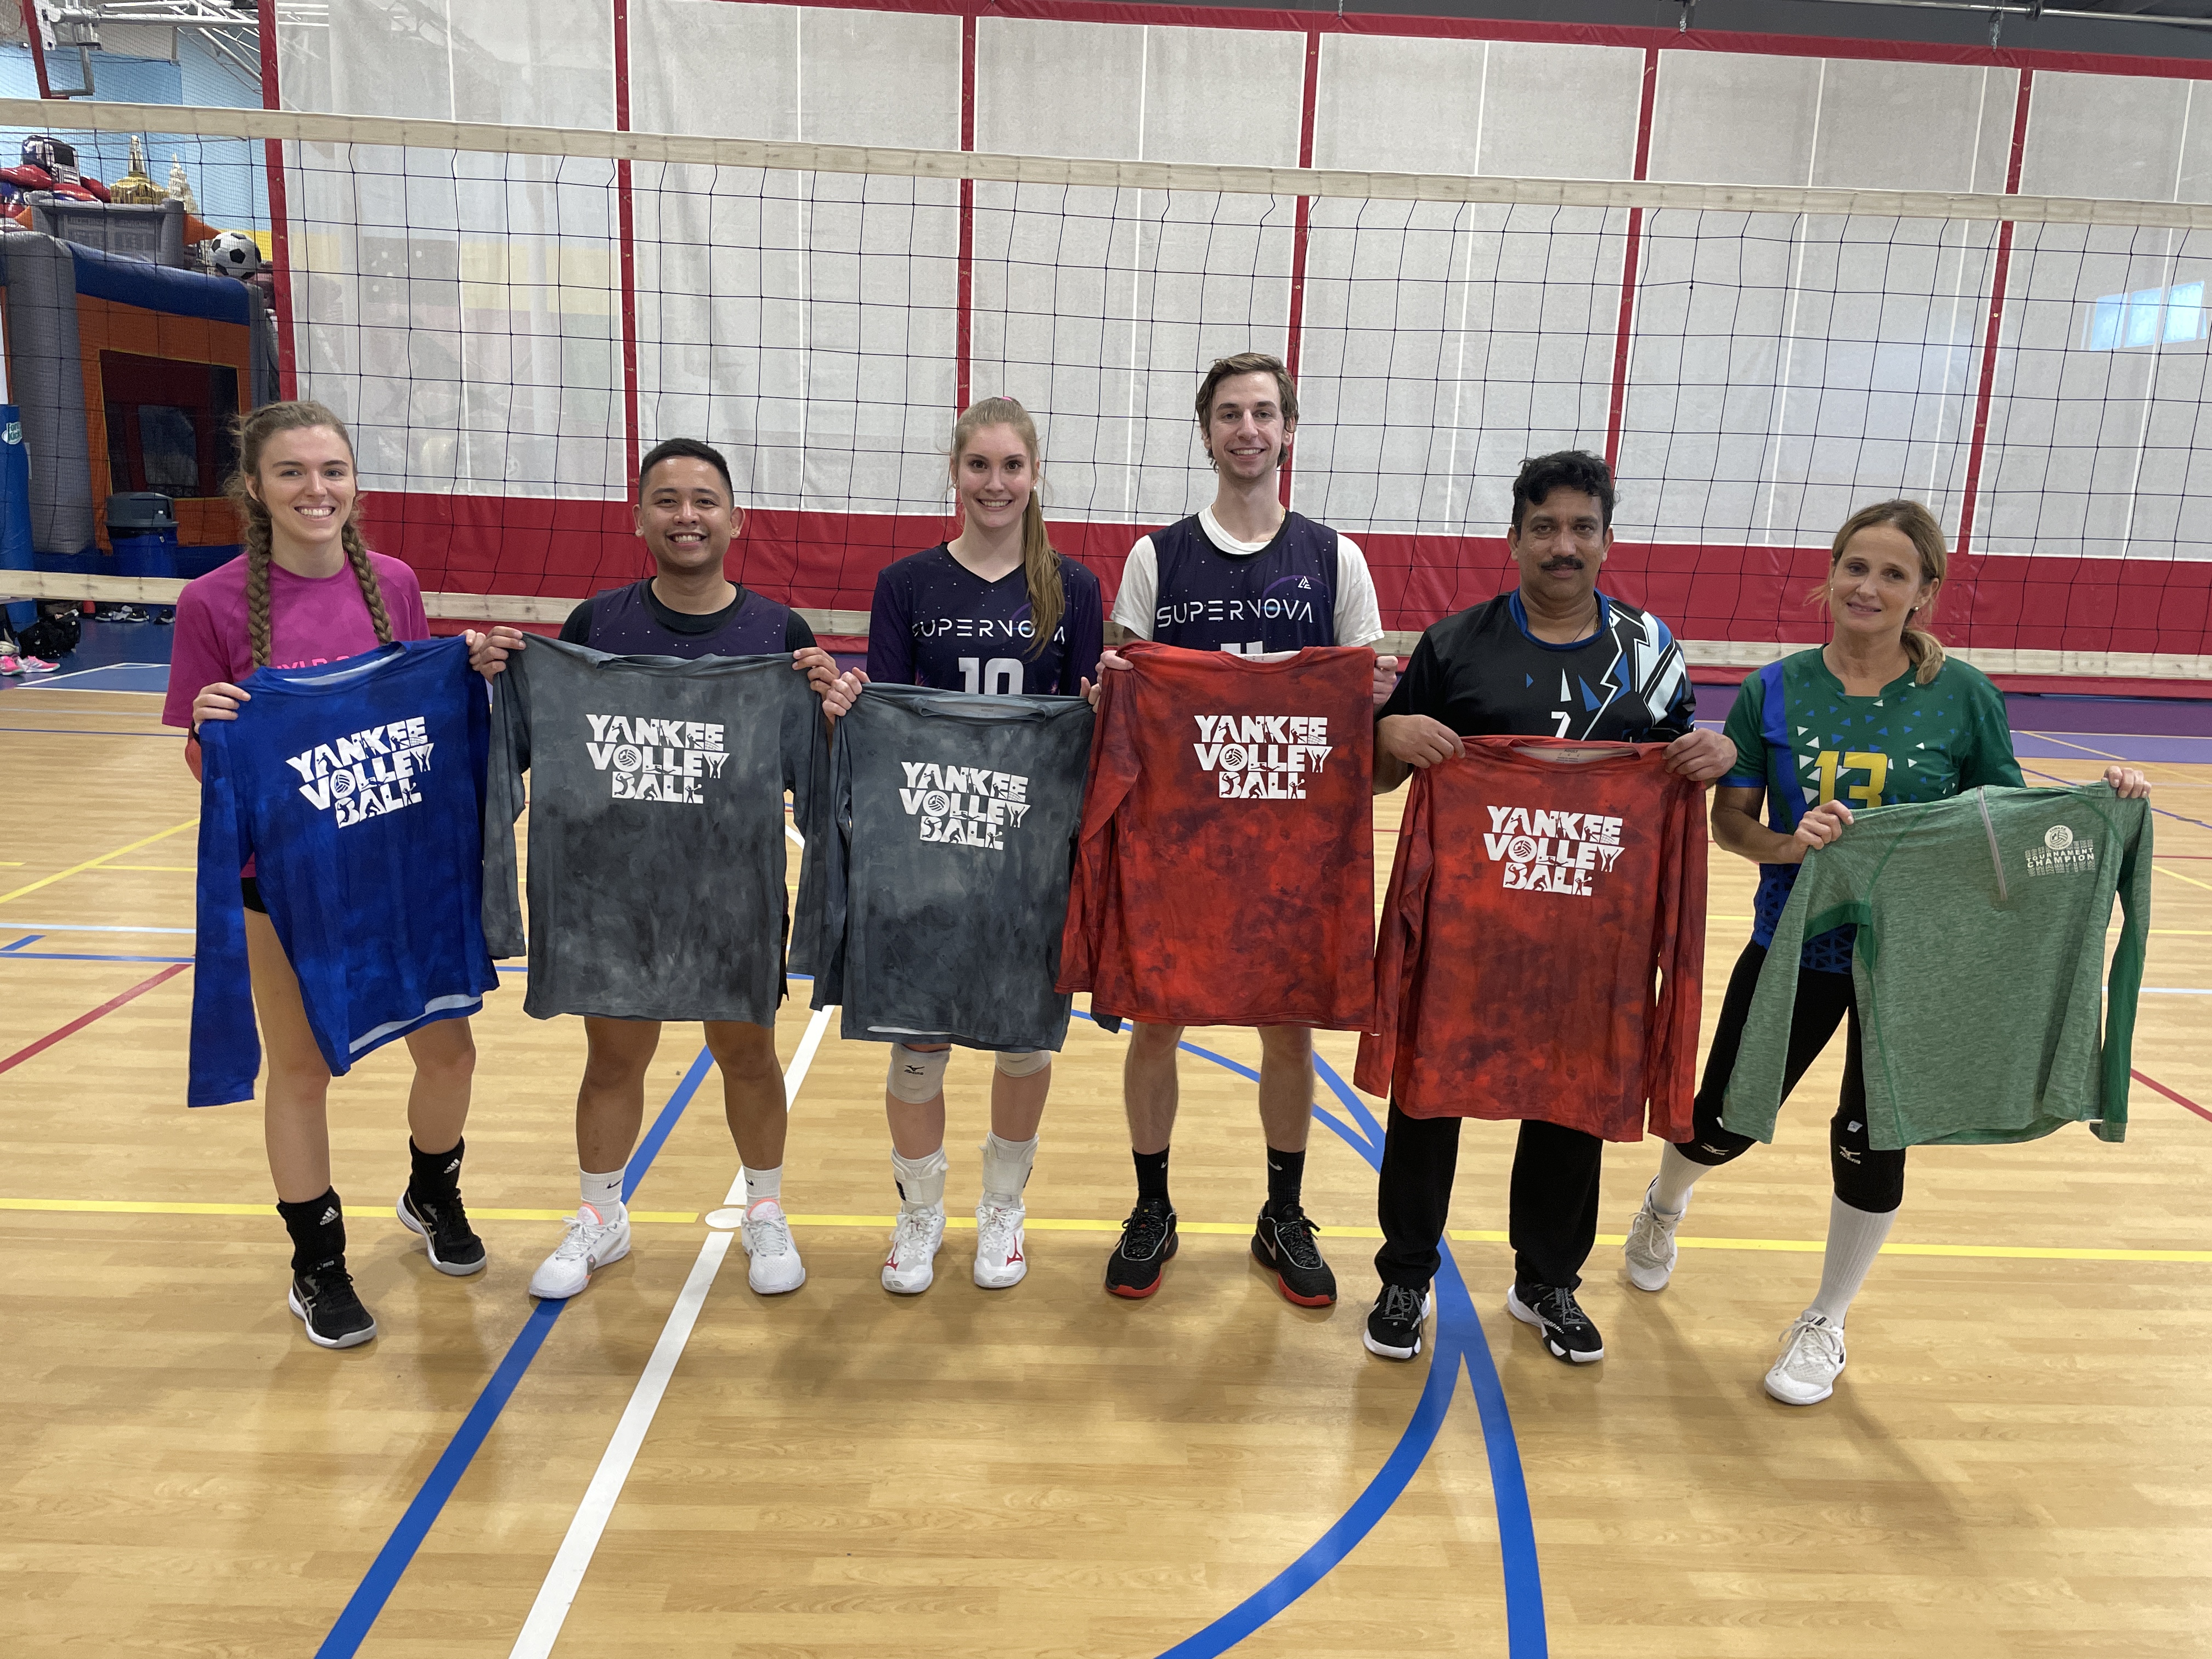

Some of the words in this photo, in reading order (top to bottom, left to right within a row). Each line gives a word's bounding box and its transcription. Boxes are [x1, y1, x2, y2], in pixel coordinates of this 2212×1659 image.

[911, 618, 1065, 645] SUPERNOA
[1156, 598, 1313, 628] SUPERNOVA
[958, 657, 1024, 695] 10
[585, 714, 724, 752] YANKEE
[1193, 715, 1328, 745] YANKEE
[285, 716, 428, 783] YANKEE
[585, 742, 730, 779] VOLLEY
[1193, 743, 1333, 773] VOLLEY
[298, 742, 435, 811] VOLLEY
[612, 771, 703, 804] BALL
[901, 761, 1029, 803] YANKEE
[1219, 771, 1306, 799] BALL
[1814, 751, 1888, 808] 13
[335, 778, 422, 828] BALL
[899, 788, 1031, 828] VOLLEY
[919, 816, 1004, 850] BALL
[1487, 805, 1623, 845] YANKEE
[1483, 833, 1625, 873] VOLLEY
[2025, 848, 2094, 863] TOURNAMENT
[2027, 853, 2095, 868] CHAMPION
[1503, 862, 1593, 896] BALL
